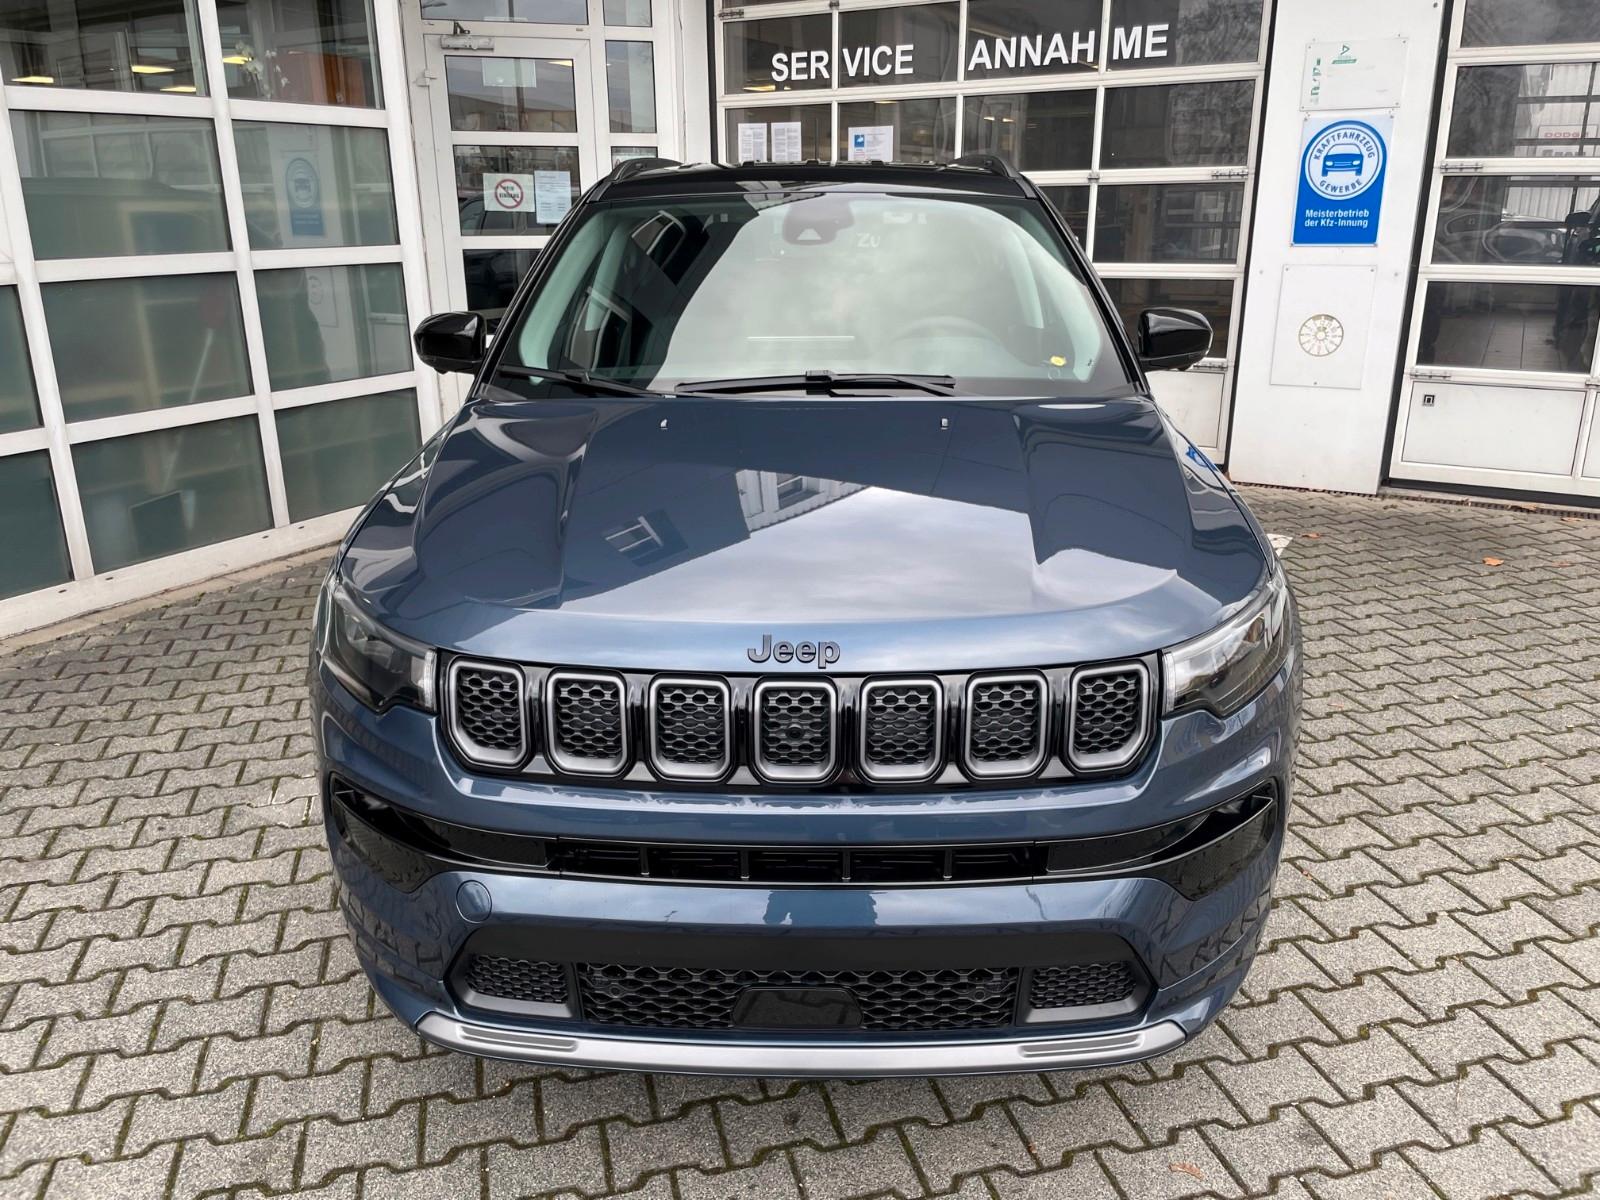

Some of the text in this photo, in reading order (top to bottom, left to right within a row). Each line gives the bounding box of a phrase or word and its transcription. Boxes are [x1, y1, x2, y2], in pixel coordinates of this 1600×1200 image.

[1313, 131, 1375, 160] KRAFTFAHRZEUG
[1320, 178, 1362, 193] GEWERBE
[1305, 209, 1370, 218] Meisterbetrieb
[1304, 218, 1369, 229] der Kfz-Innung
[747, 634, 840, 669] Jeep
